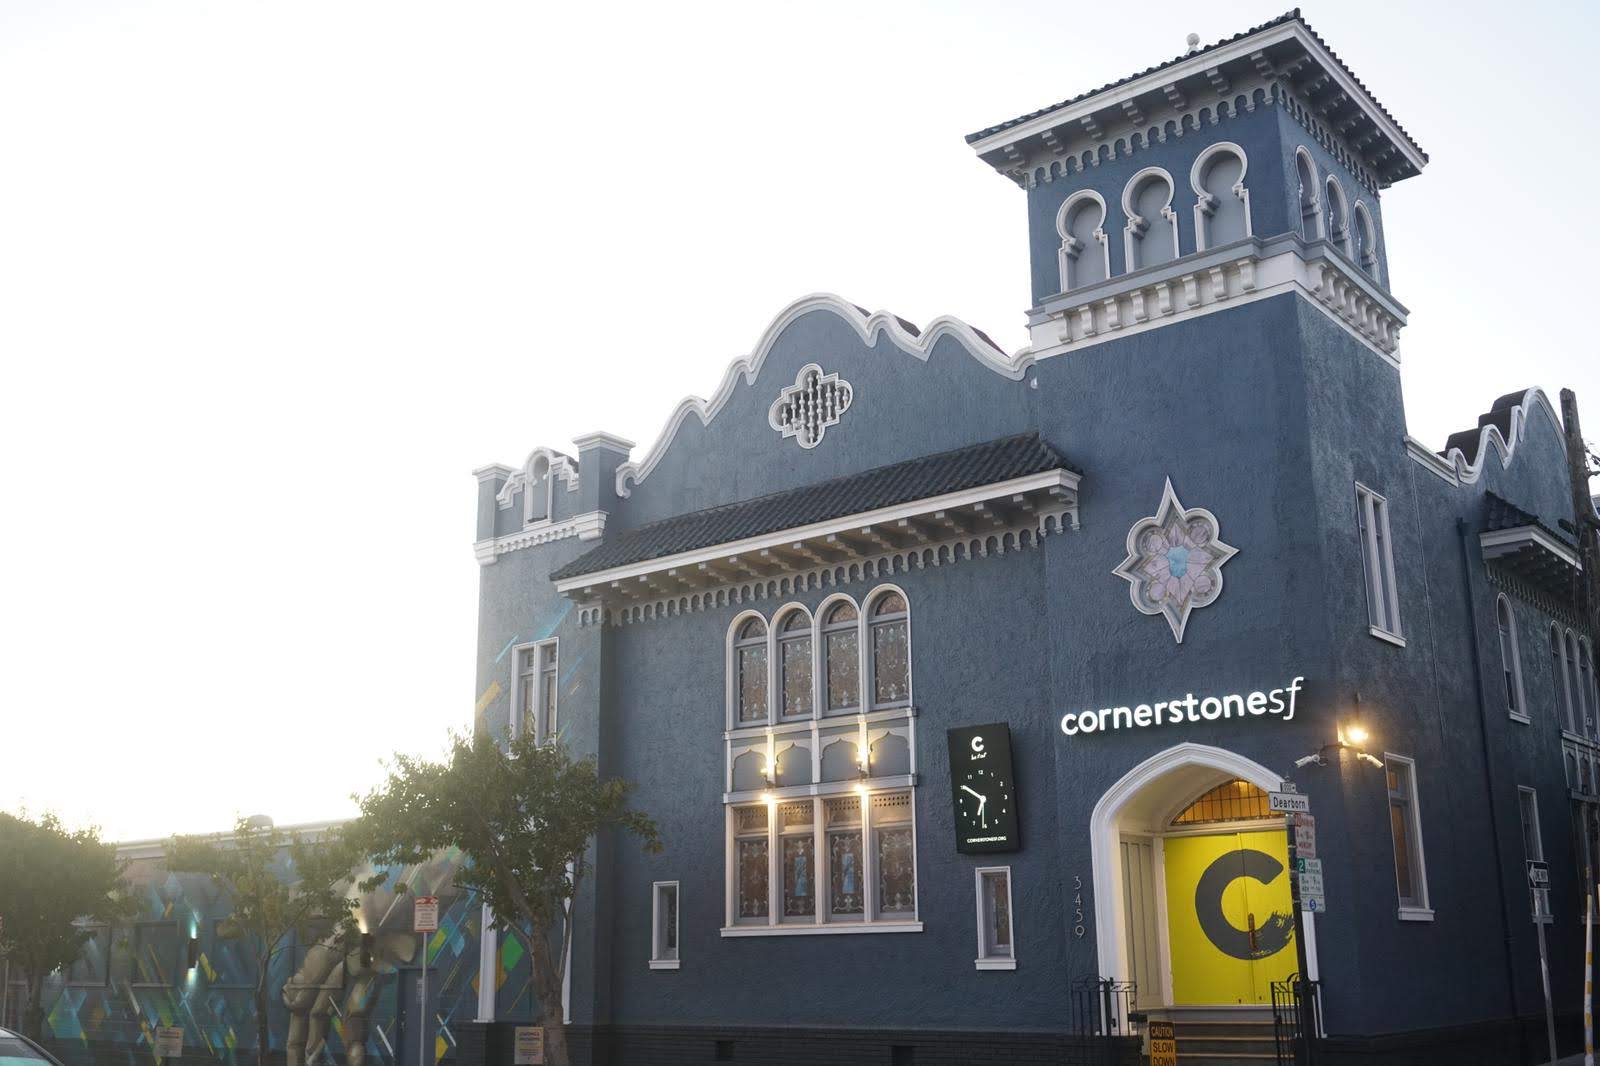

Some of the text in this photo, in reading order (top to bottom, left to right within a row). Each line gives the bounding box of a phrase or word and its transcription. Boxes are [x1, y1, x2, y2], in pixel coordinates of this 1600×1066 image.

[1061, 676, 1304, 736] cornerstonesf
[1273, 796, 1306, 810] Dearborn
[1151, 1026, 1173, 1037] CAUTION
[1153, 1041, 1174, 1053] SLOW
